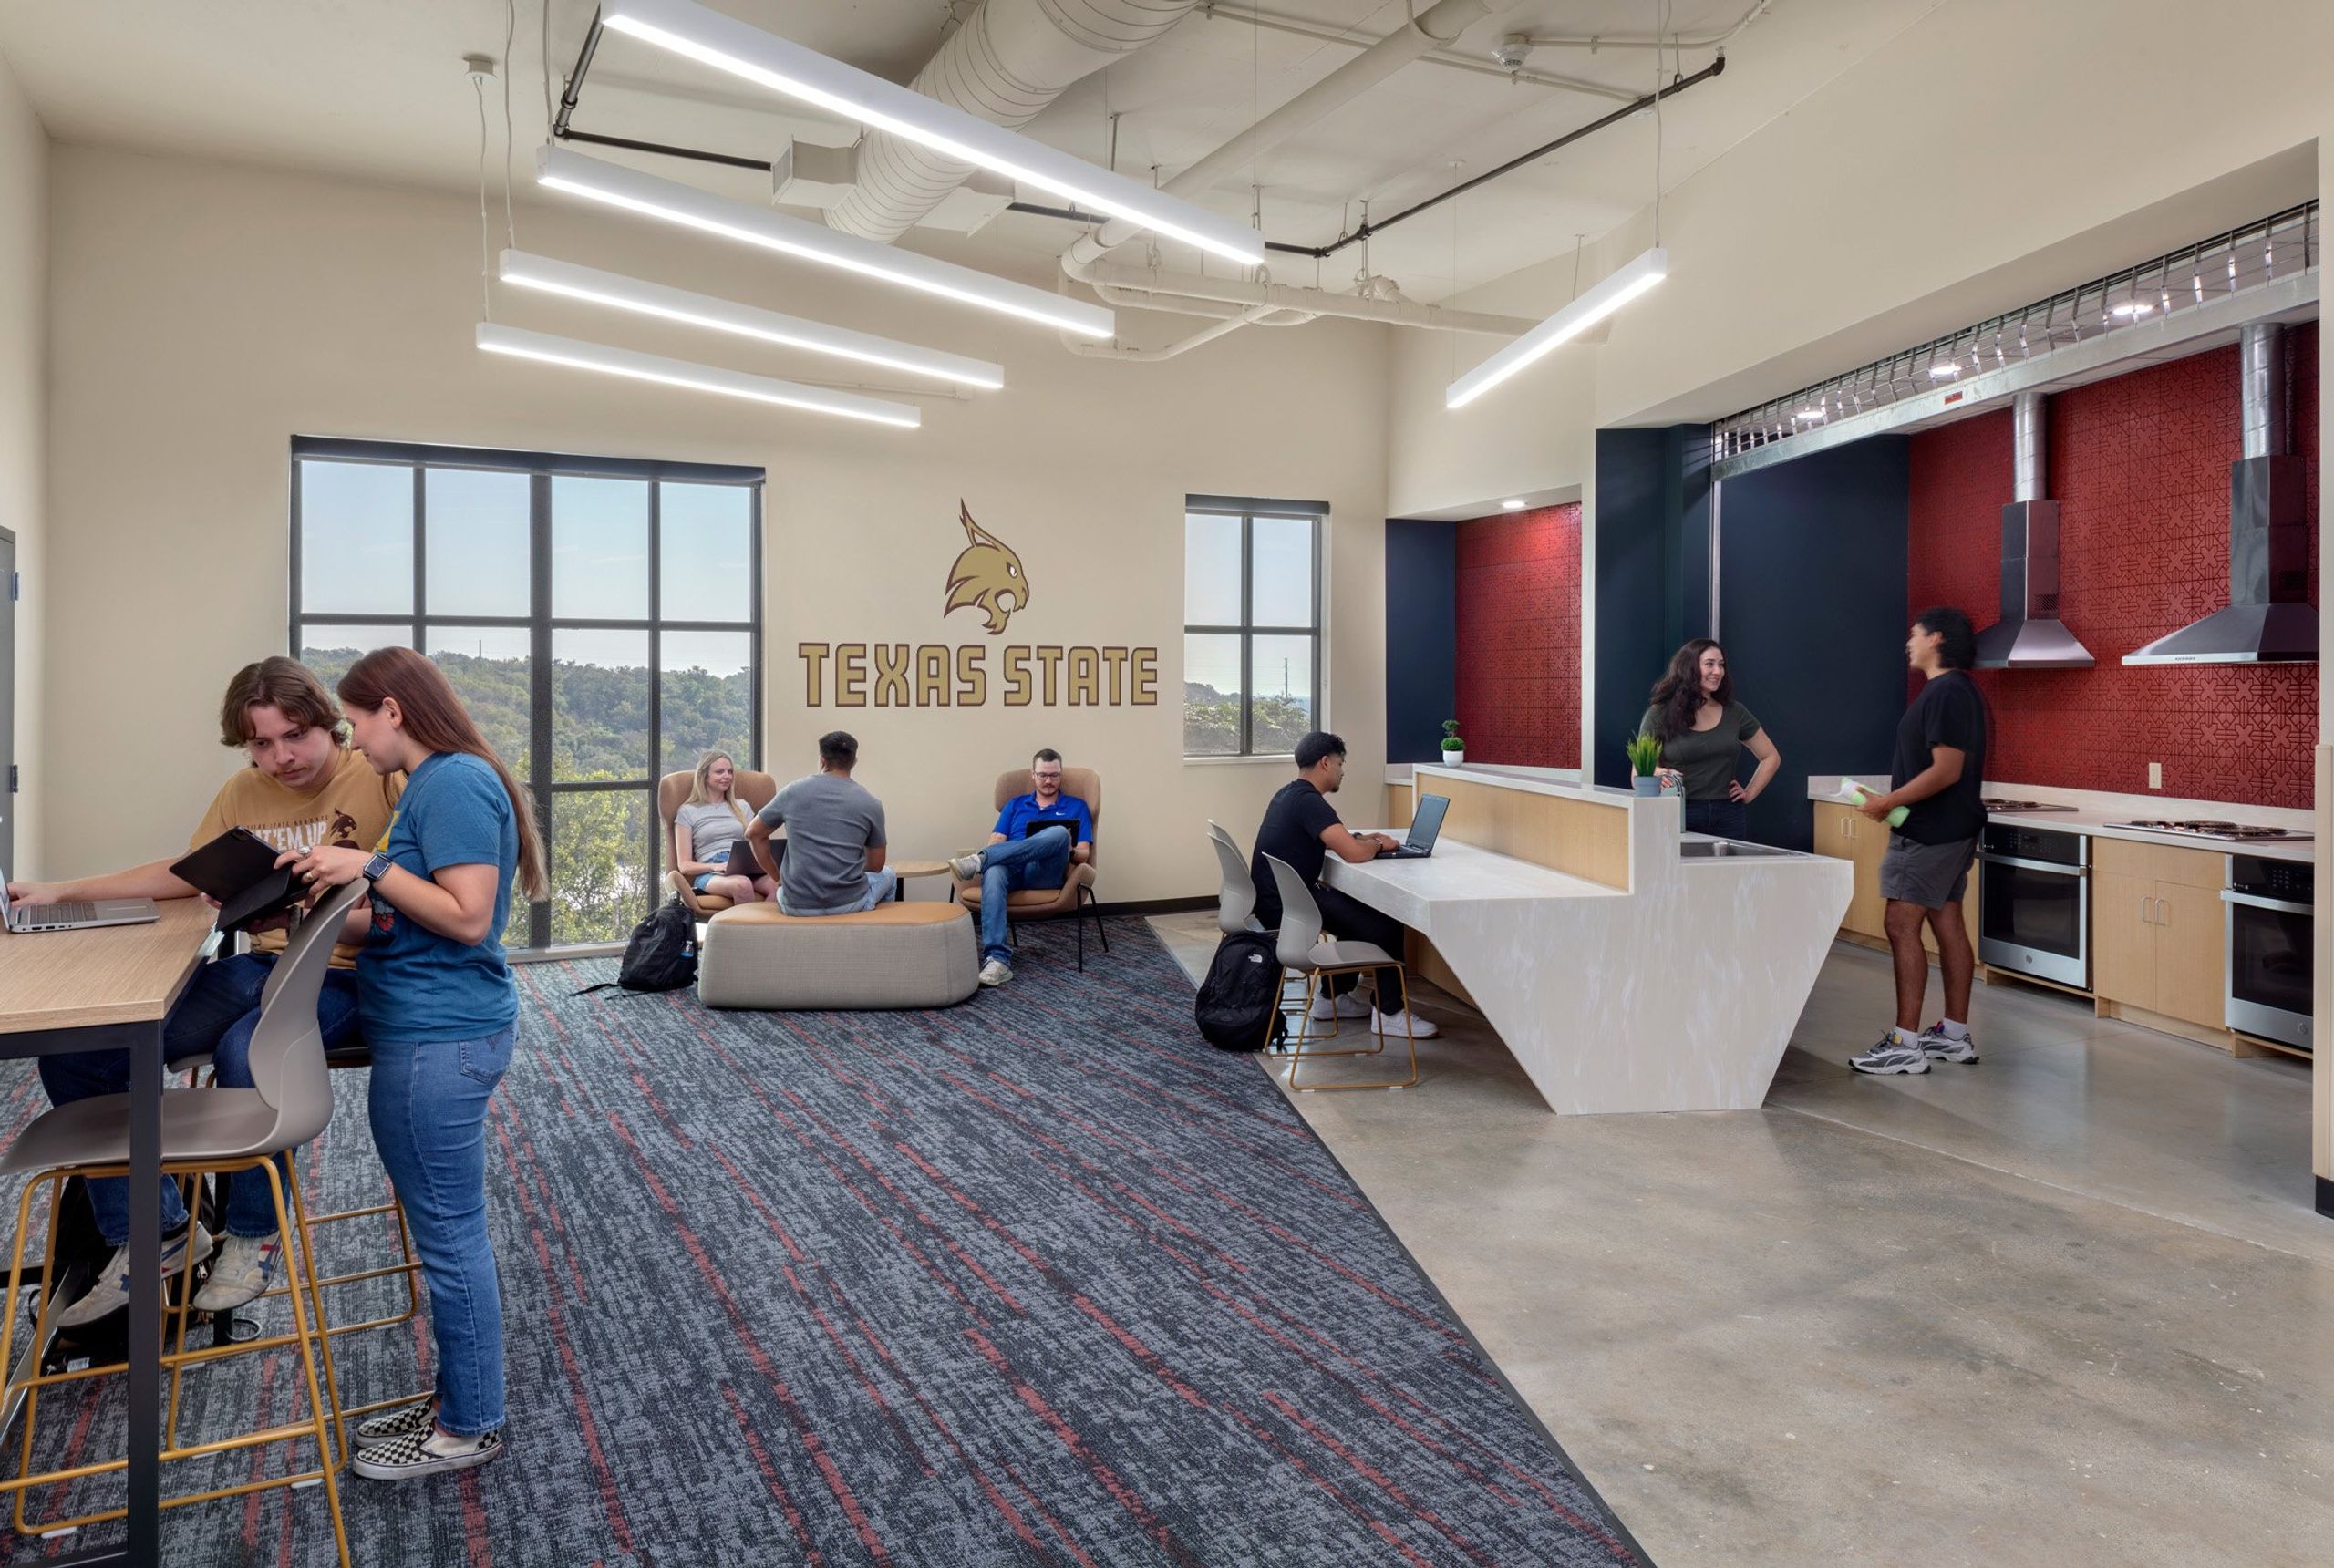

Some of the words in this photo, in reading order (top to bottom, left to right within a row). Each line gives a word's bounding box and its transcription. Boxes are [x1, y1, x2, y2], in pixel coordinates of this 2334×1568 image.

[799, 643, 986, 707] TEXAS
[1003, 645, 1158, 707] STATE
[305, 821, 327, 848] UP
